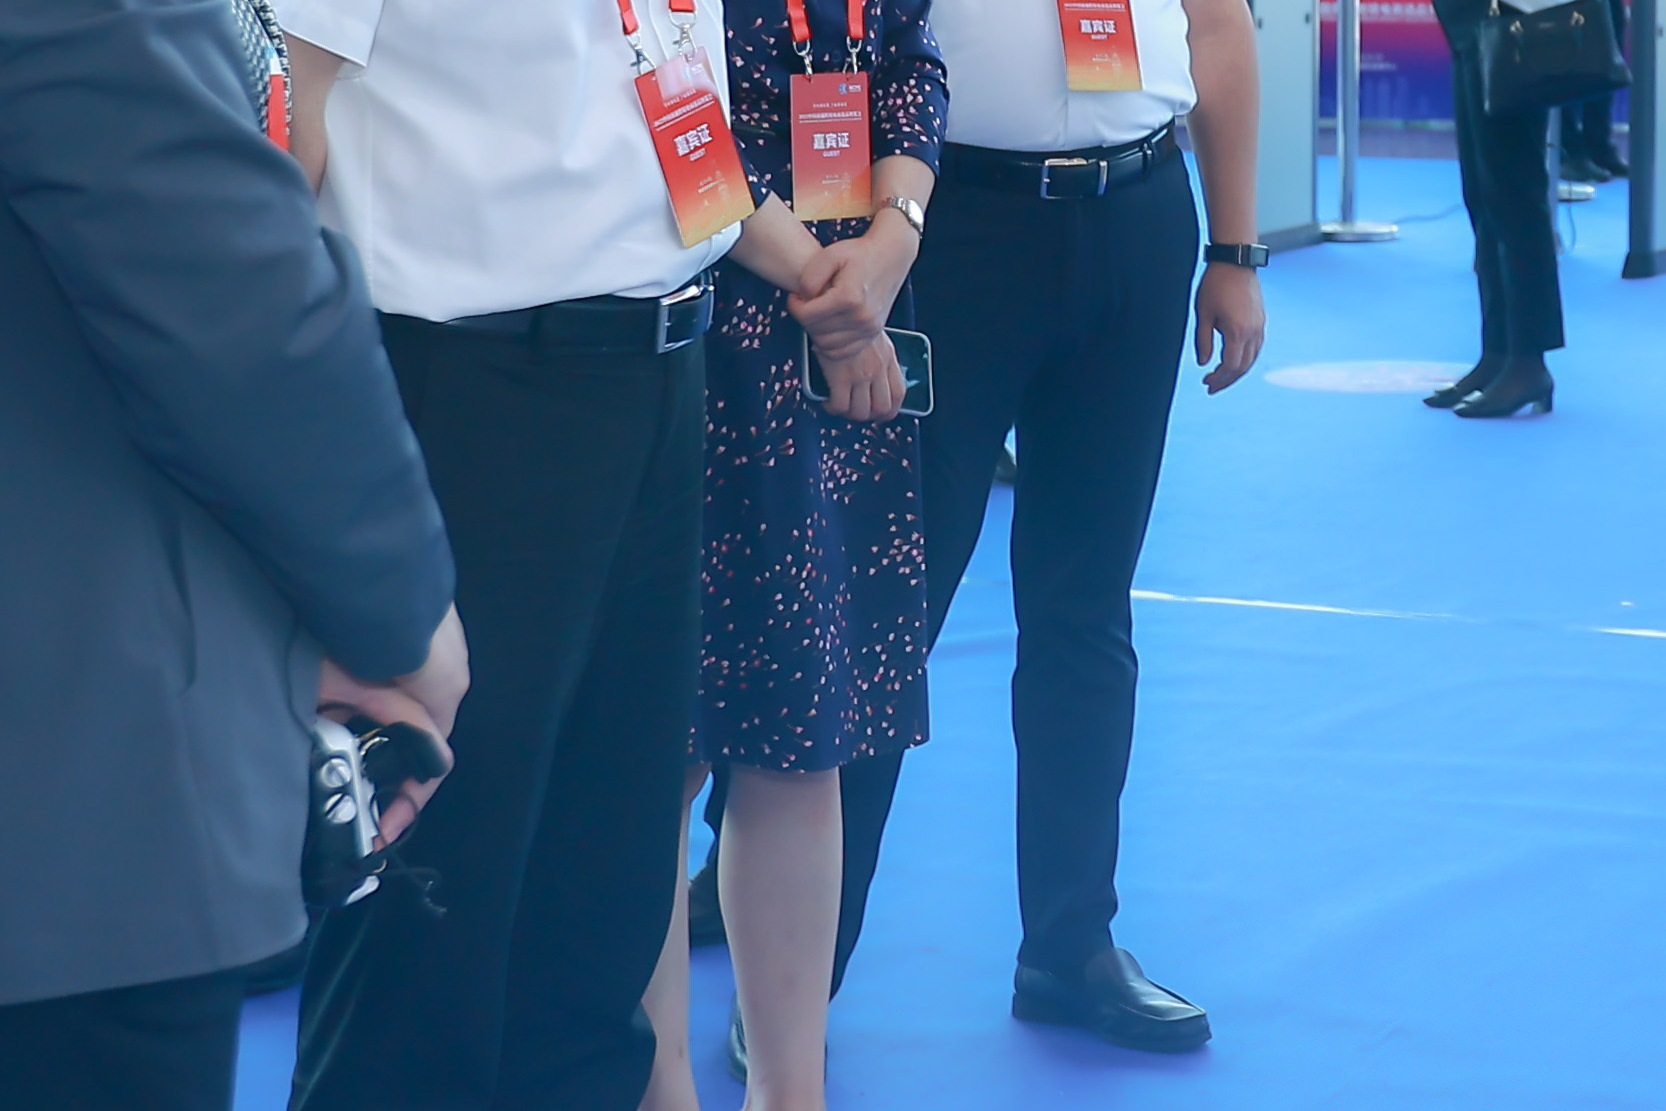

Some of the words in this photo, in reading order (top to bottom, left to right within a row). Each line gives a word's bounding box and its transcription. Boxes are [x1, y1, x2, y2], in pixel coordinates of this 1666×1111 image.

[674, 123, 713, 157] 嘉宾证
[813, 133, 850, 150] 嘉宾证
[822, 150, 841, 158] GUEST
